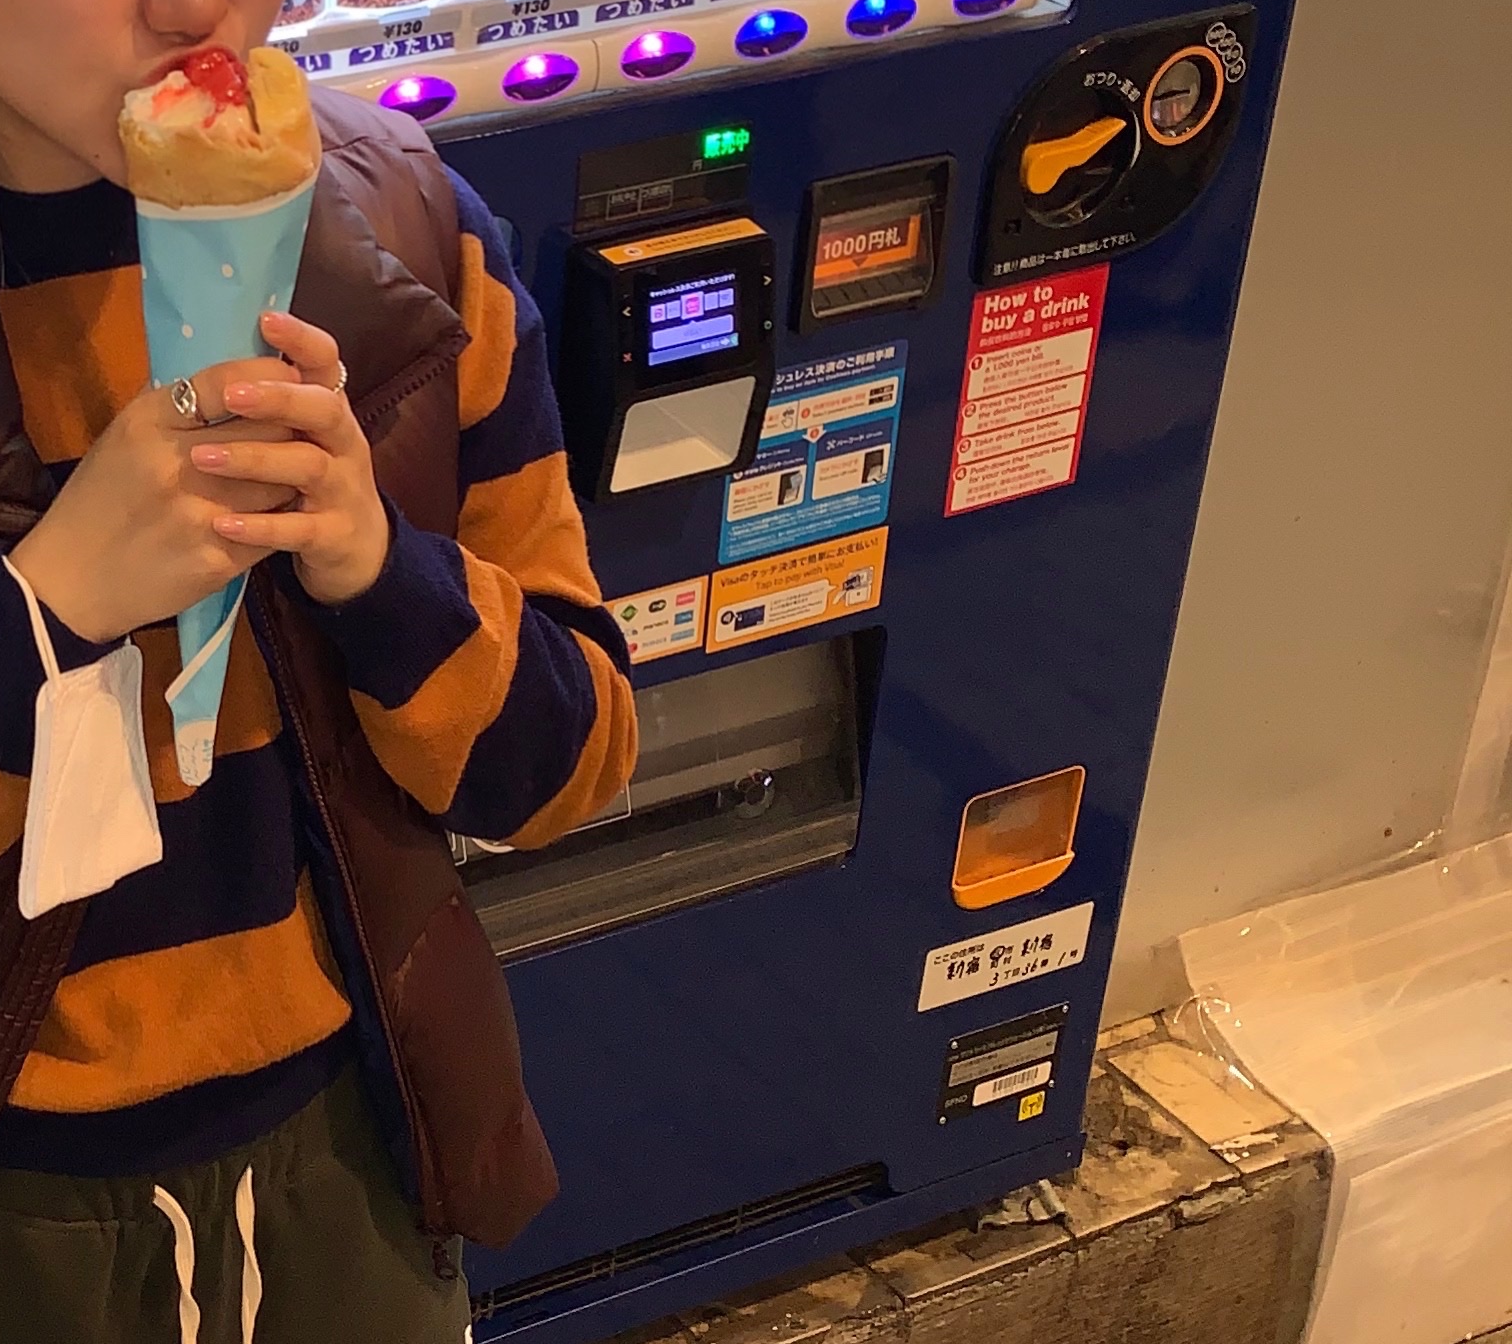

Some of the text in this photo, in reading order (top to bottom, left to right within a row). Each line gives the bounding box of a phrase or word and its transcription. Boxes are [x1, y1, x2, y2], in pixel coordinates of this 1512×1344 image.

[384, 20, 423, 39] ¥130
[489, 11, 574, 41] つめたい
[359, 34, 445, 62] つめたい
[822, 226, 901, 259] 1000円札
[981, 312, 1018, 334] buy
[1023, 308, 1036, 324] a
[1040, 292, 1090, 319] drink
[984, 285, 1054, 315] How to
